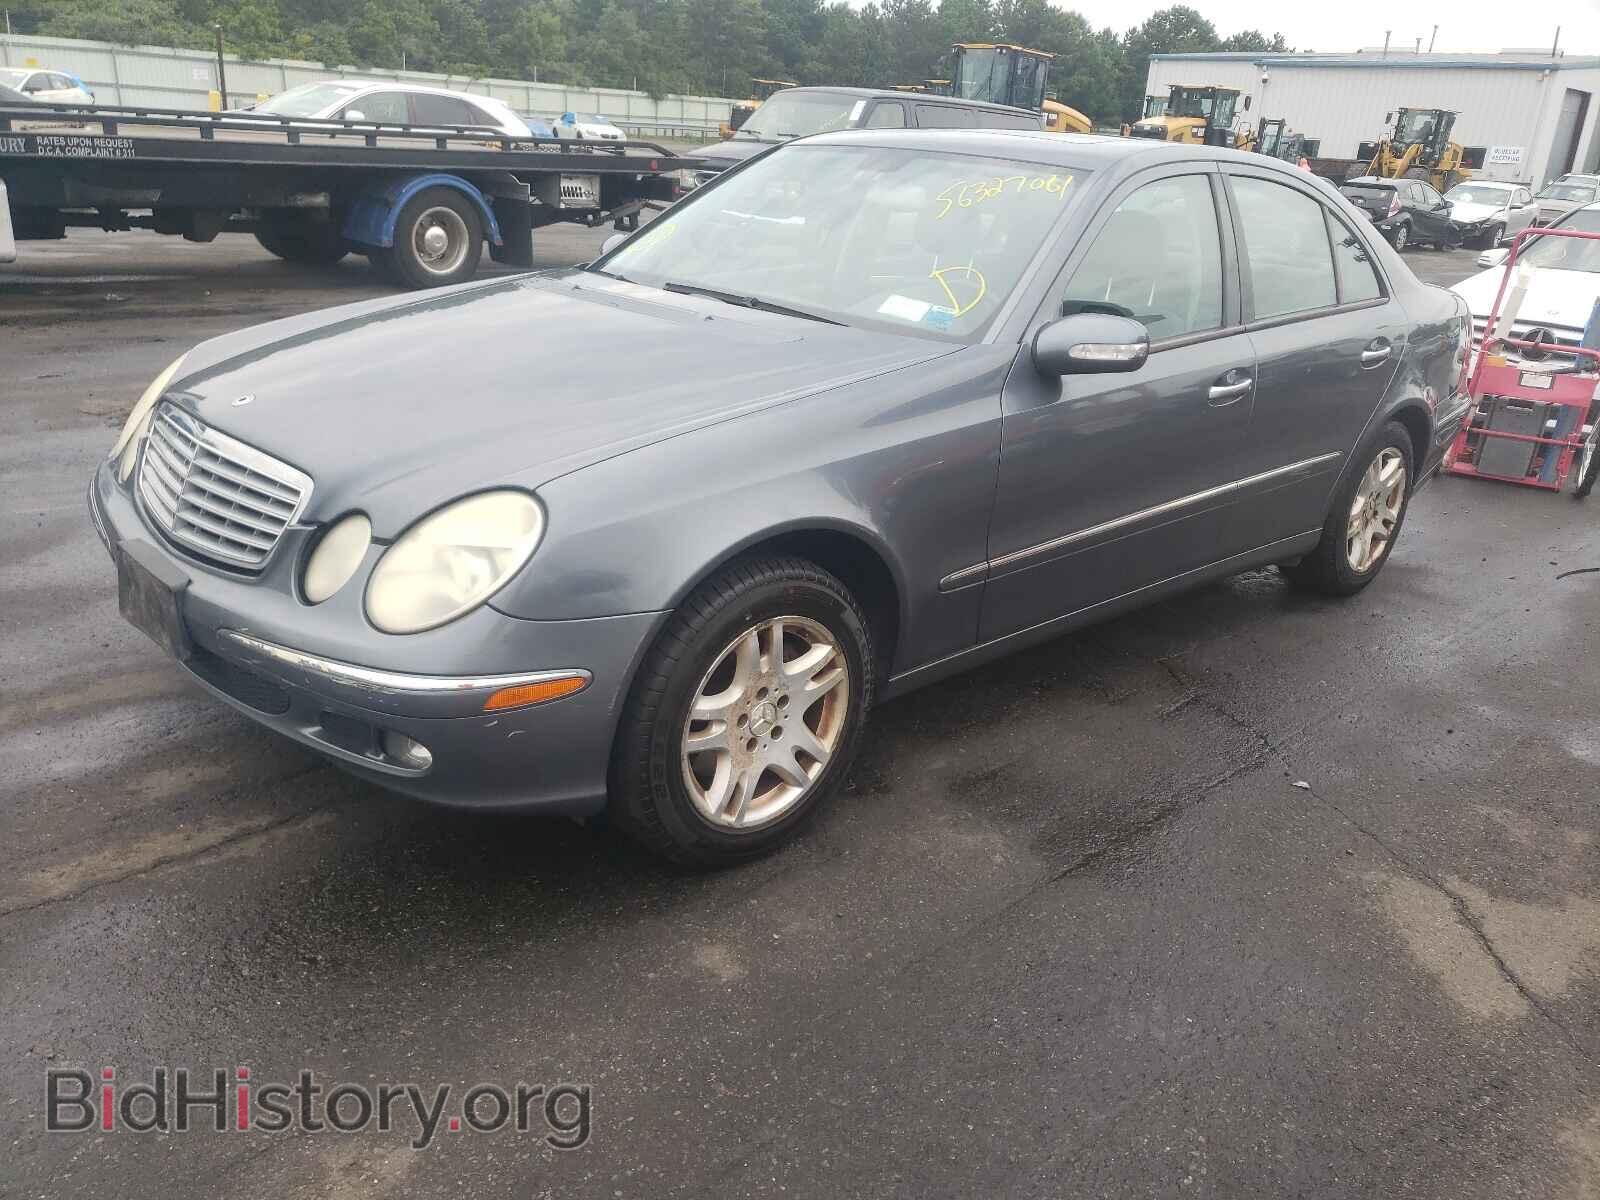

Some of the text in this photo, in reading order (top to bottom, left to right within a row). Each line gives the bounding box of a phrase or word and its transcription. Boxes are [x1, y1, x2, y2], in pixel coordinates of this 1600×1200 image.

[37, 136, 133, 148] RATES UPON REQUEST
[65, 148, 114, 157] COMPLAINT
